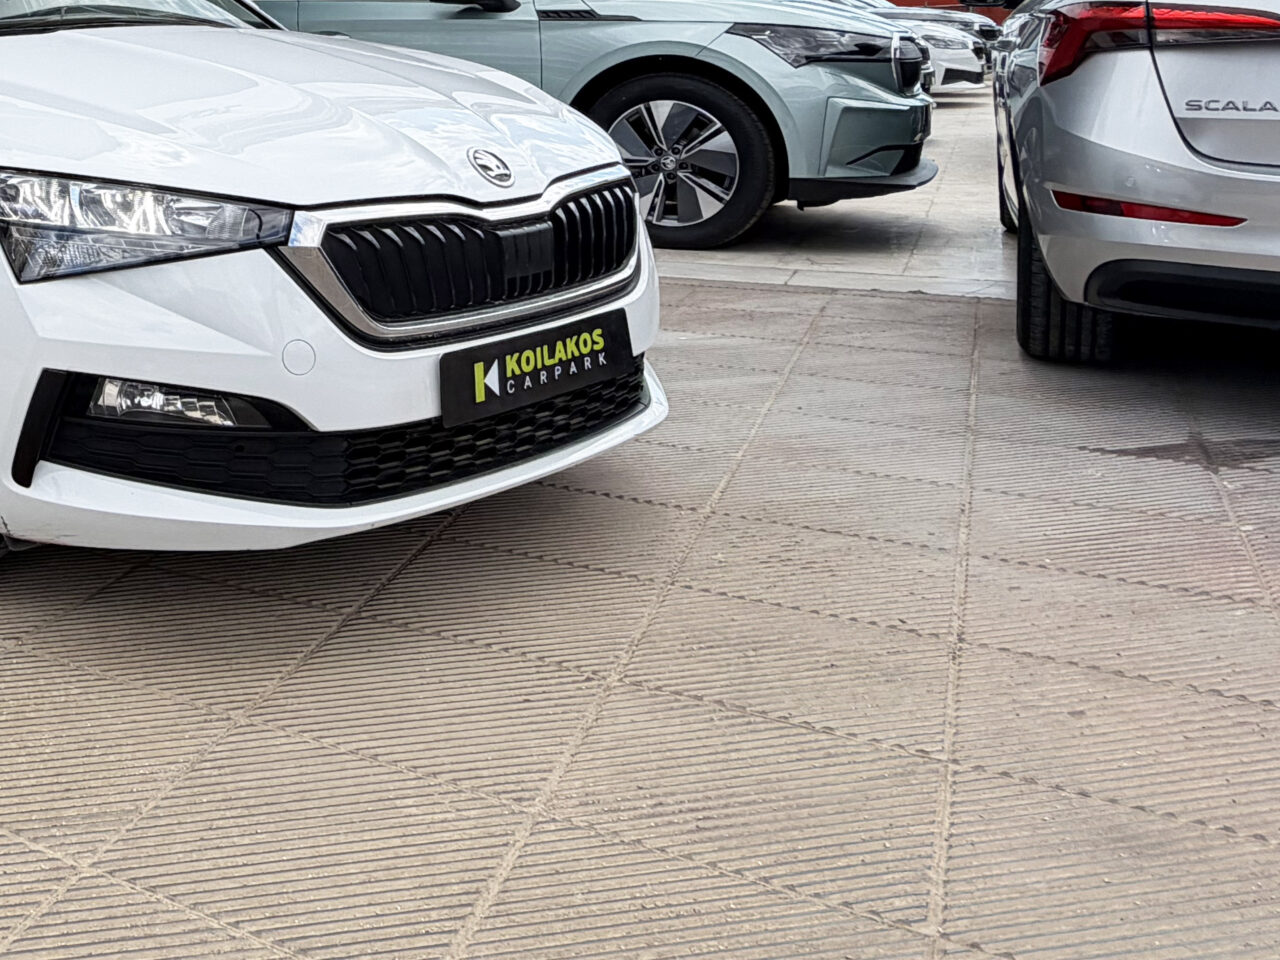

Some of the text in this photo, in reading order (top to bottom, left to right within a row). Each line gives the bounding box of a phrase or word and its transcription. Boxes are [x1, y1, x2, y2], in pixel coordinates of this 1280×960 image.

[1184, 99, 1280, 113] SCALA
[505, 328, 605, 378] KOILAKOS
[506, 351, 608, 395] CARPARK
